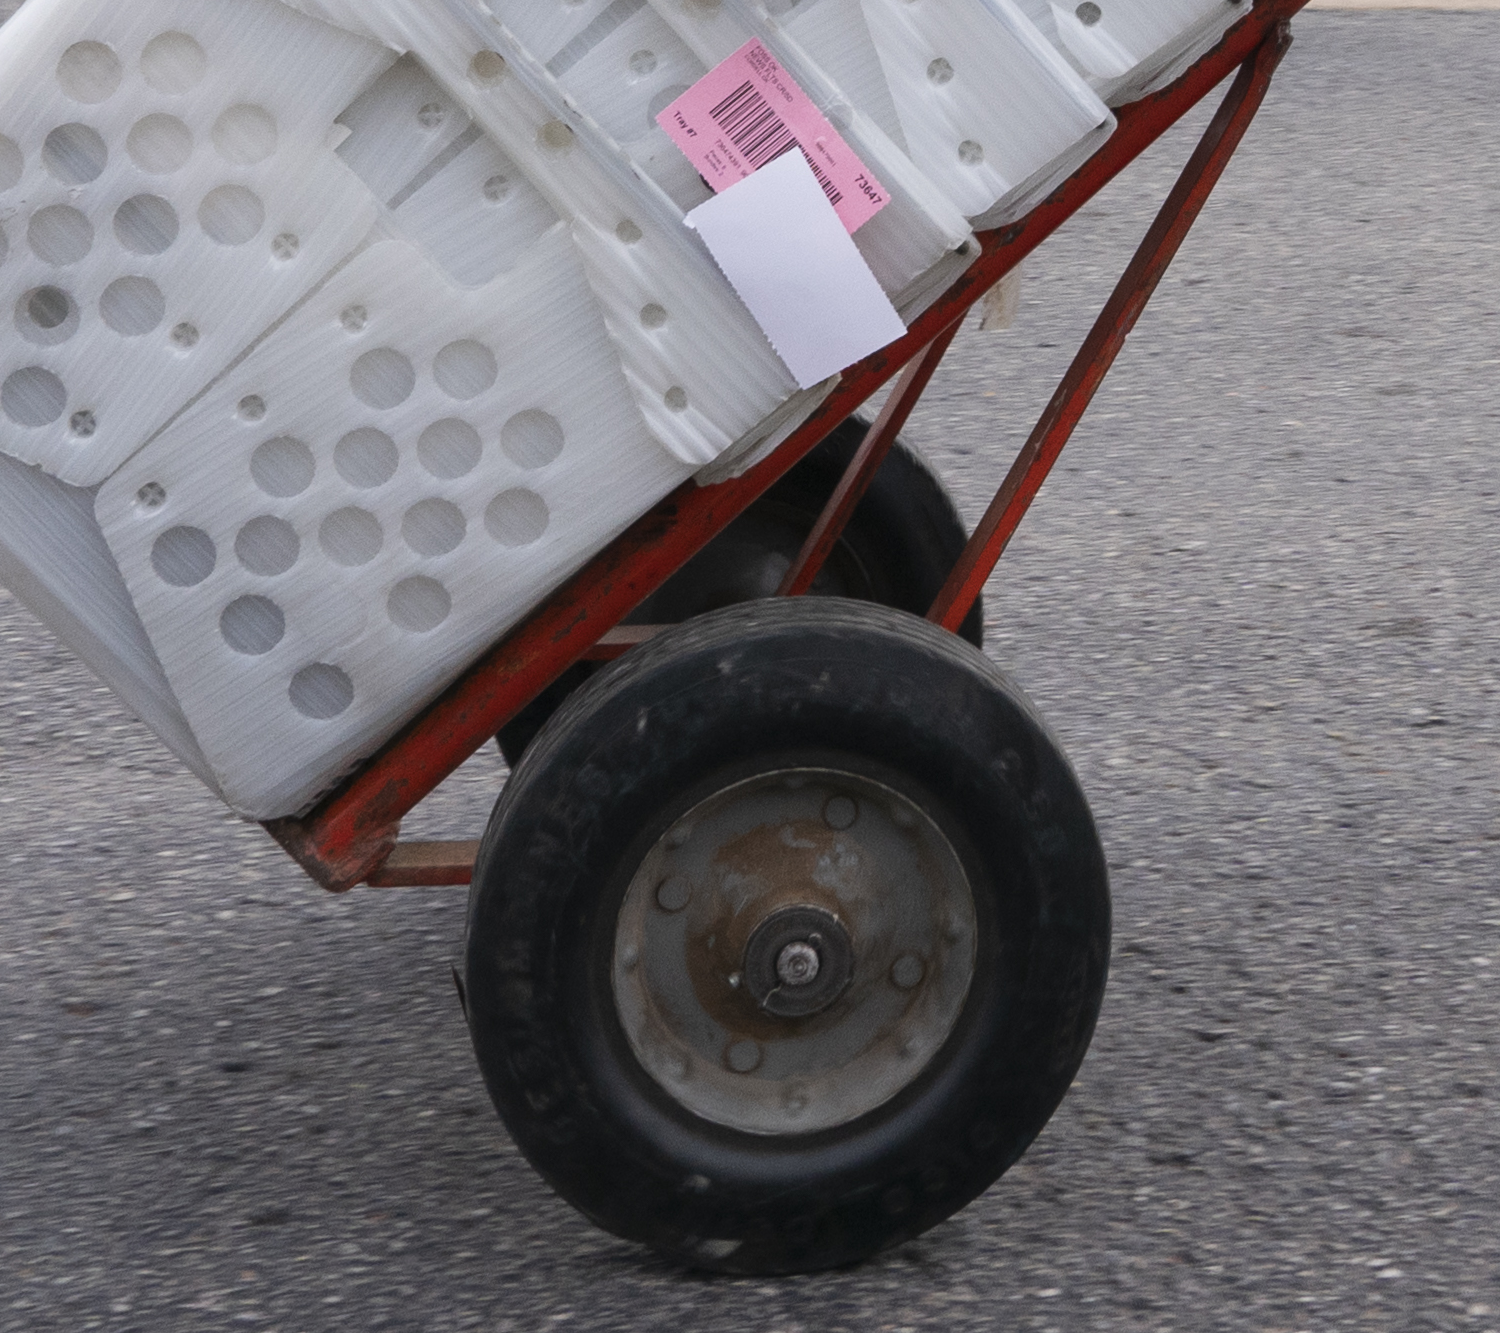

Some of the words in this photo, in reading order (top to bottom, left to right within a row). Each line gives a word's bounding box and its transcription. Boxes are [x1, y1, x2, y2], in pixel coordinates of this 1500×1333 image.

[749, 50, 765, 68] NEWS
[763, 68, 778, 84] FLTS
[755, 46, 770, 62] FOSS
[768, 61, 778, 71] OK
[671, 111, 689, 129] Tray
[686, 128, 697, 138] #7
[853, 174, 882, 205] 73647
